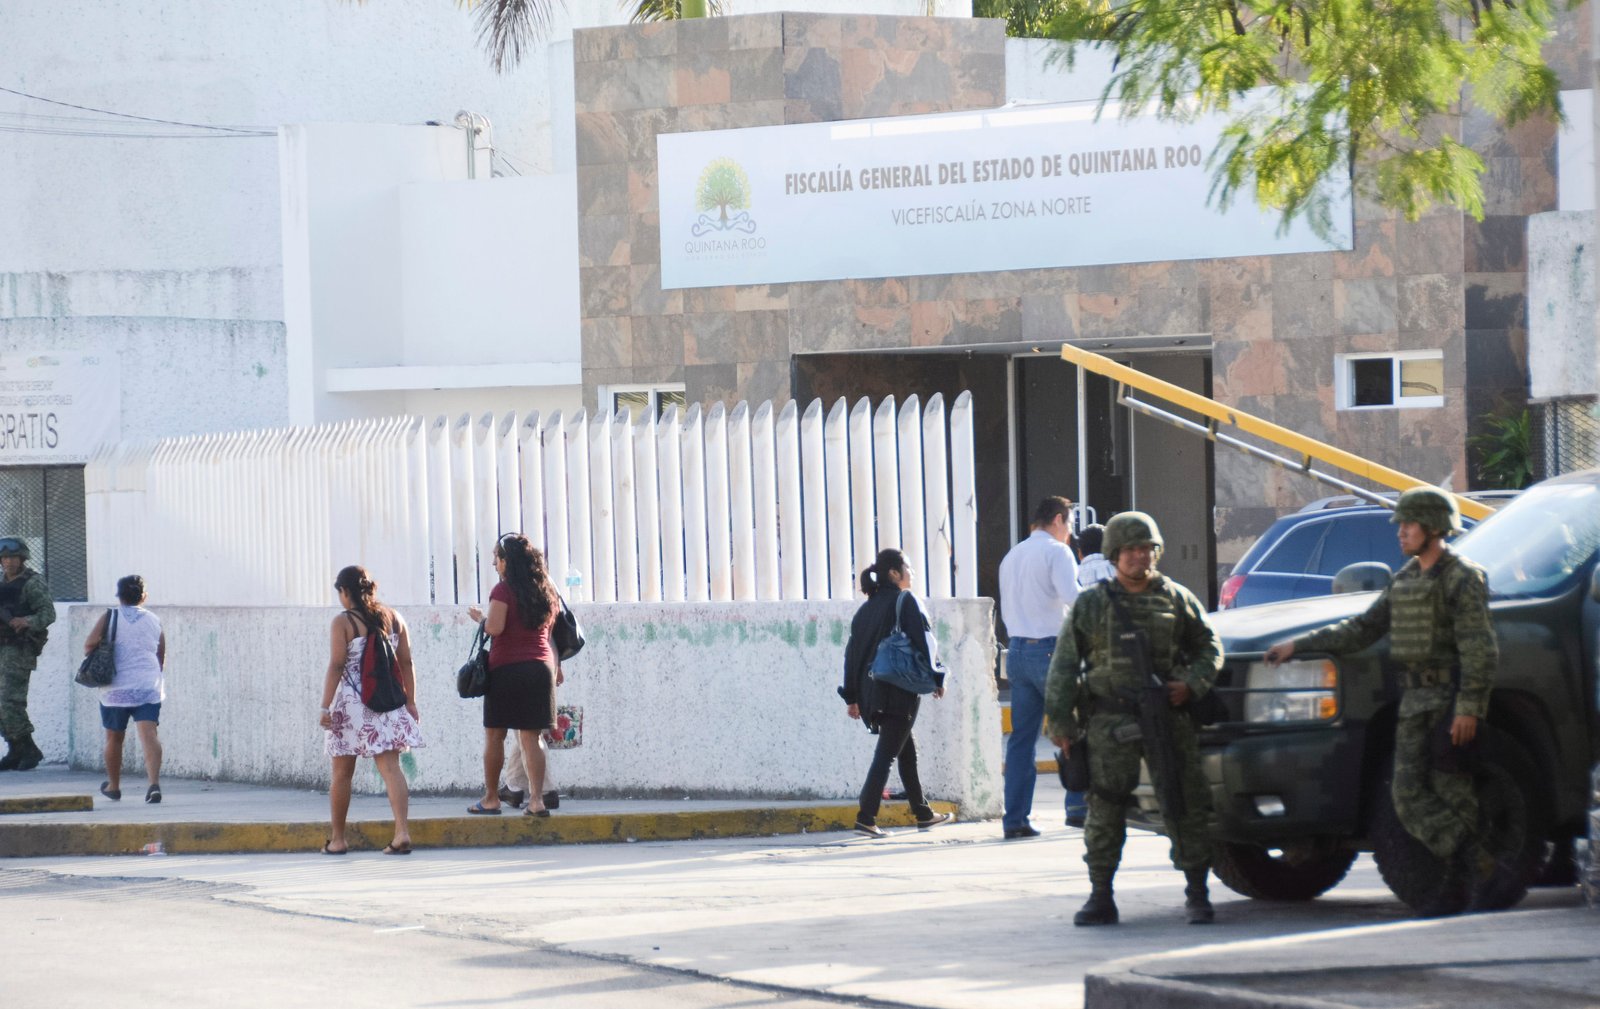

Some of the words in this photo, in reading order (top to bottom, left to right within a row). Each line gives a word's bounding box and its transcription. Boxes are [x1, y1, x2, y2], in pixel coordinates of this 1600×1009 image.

[785, 164, 854, 195] FISCALÍA
[859, 164, 932, 190] GENERAL
[938, 162, 967, 185] DEL
[973, 157, 1034, 183] ESTADO
[1041, 154, 1062, 177] DE
[1069, 148, 1158, 177] QUINTANA
[1164, 144, 1202, 169] ROO
[891, 199, 987, 225] VICEFISCALÍA
[991, 201, 1037, 219] ZONA
[1041, 196, 1091, 216] NORTE
[685, 239, 738, 254] QUINTANA
[741, 236, 767, 249] ROO
